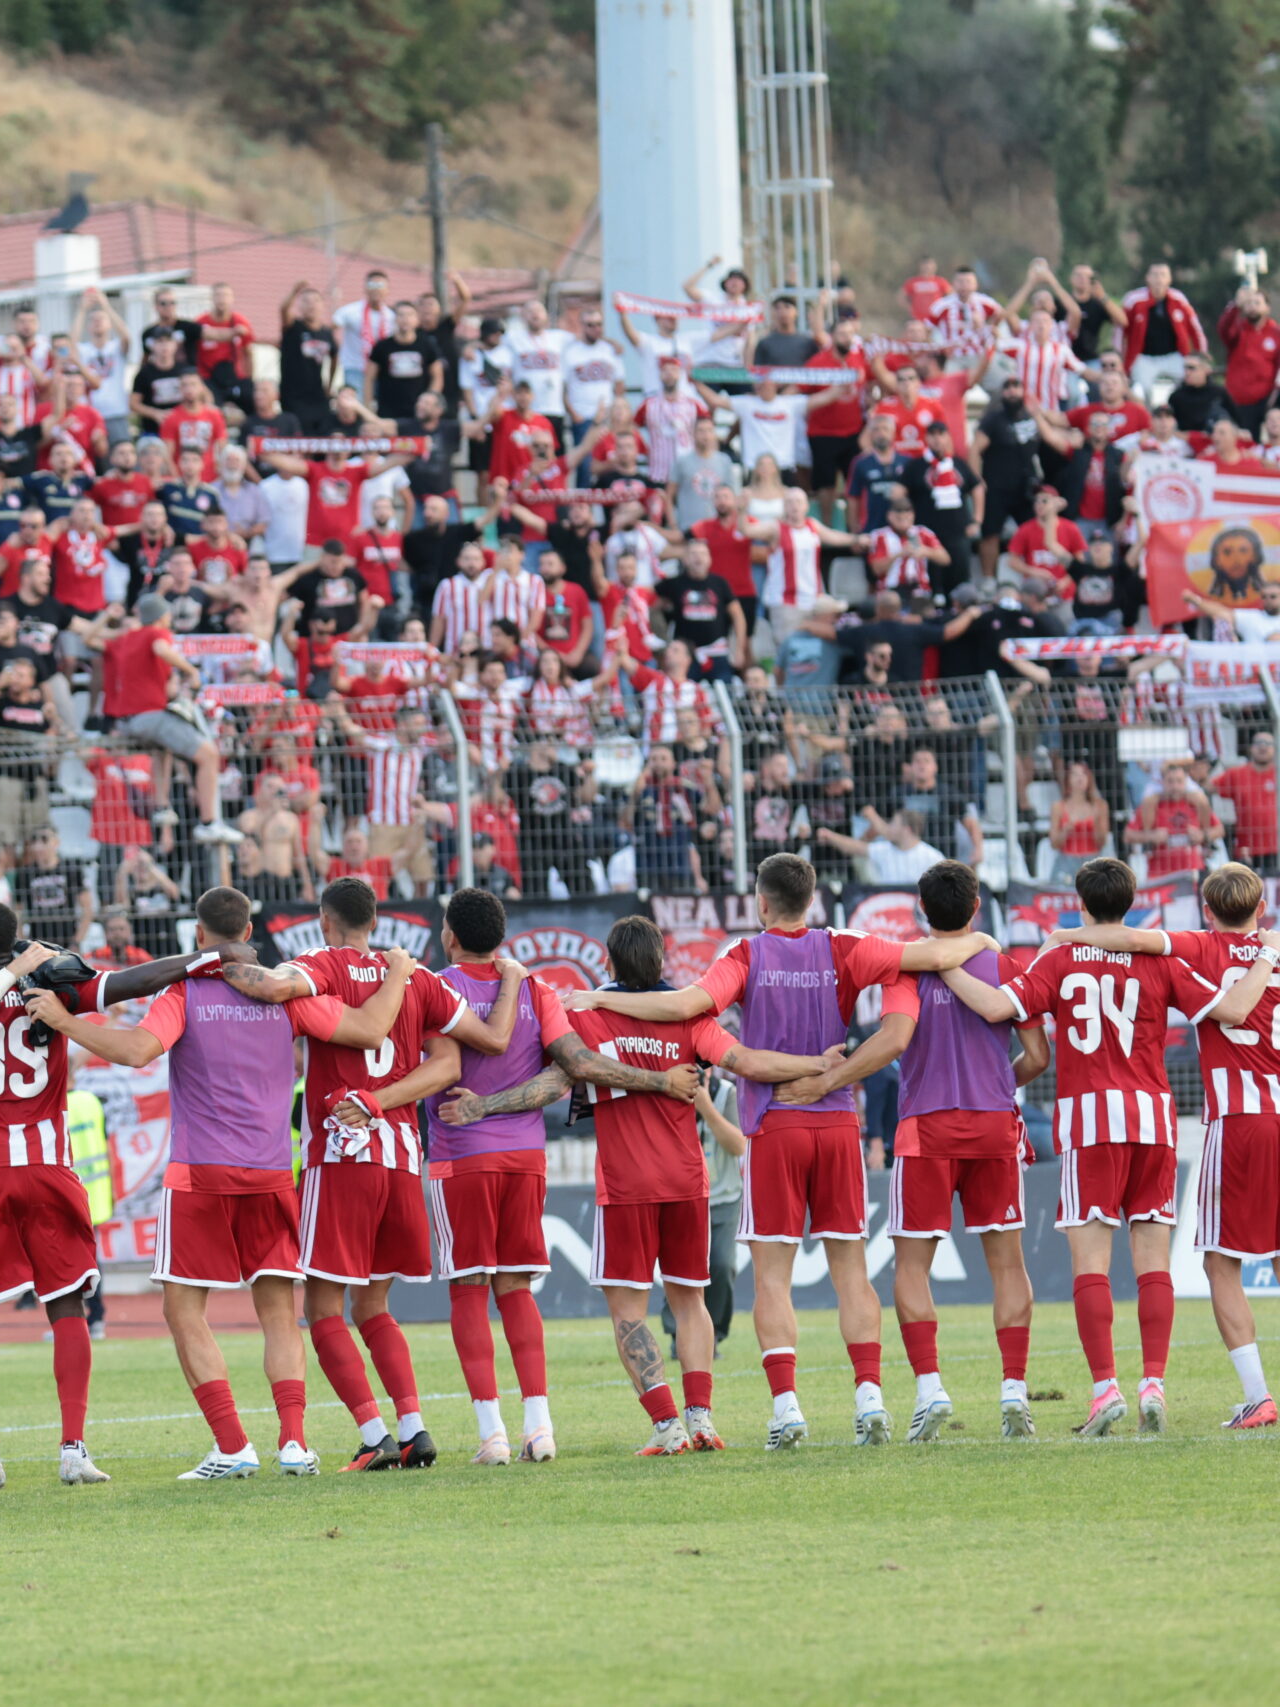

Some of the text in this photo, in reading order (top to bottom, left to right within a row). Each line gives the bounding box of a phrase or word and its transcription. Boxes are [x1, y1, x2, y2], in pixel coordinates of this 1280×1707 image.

[266, 1004, 281, 1021] FC
[1059, 972, 1140, 1059] 34
[665, 1042, 680, 1060] FC
